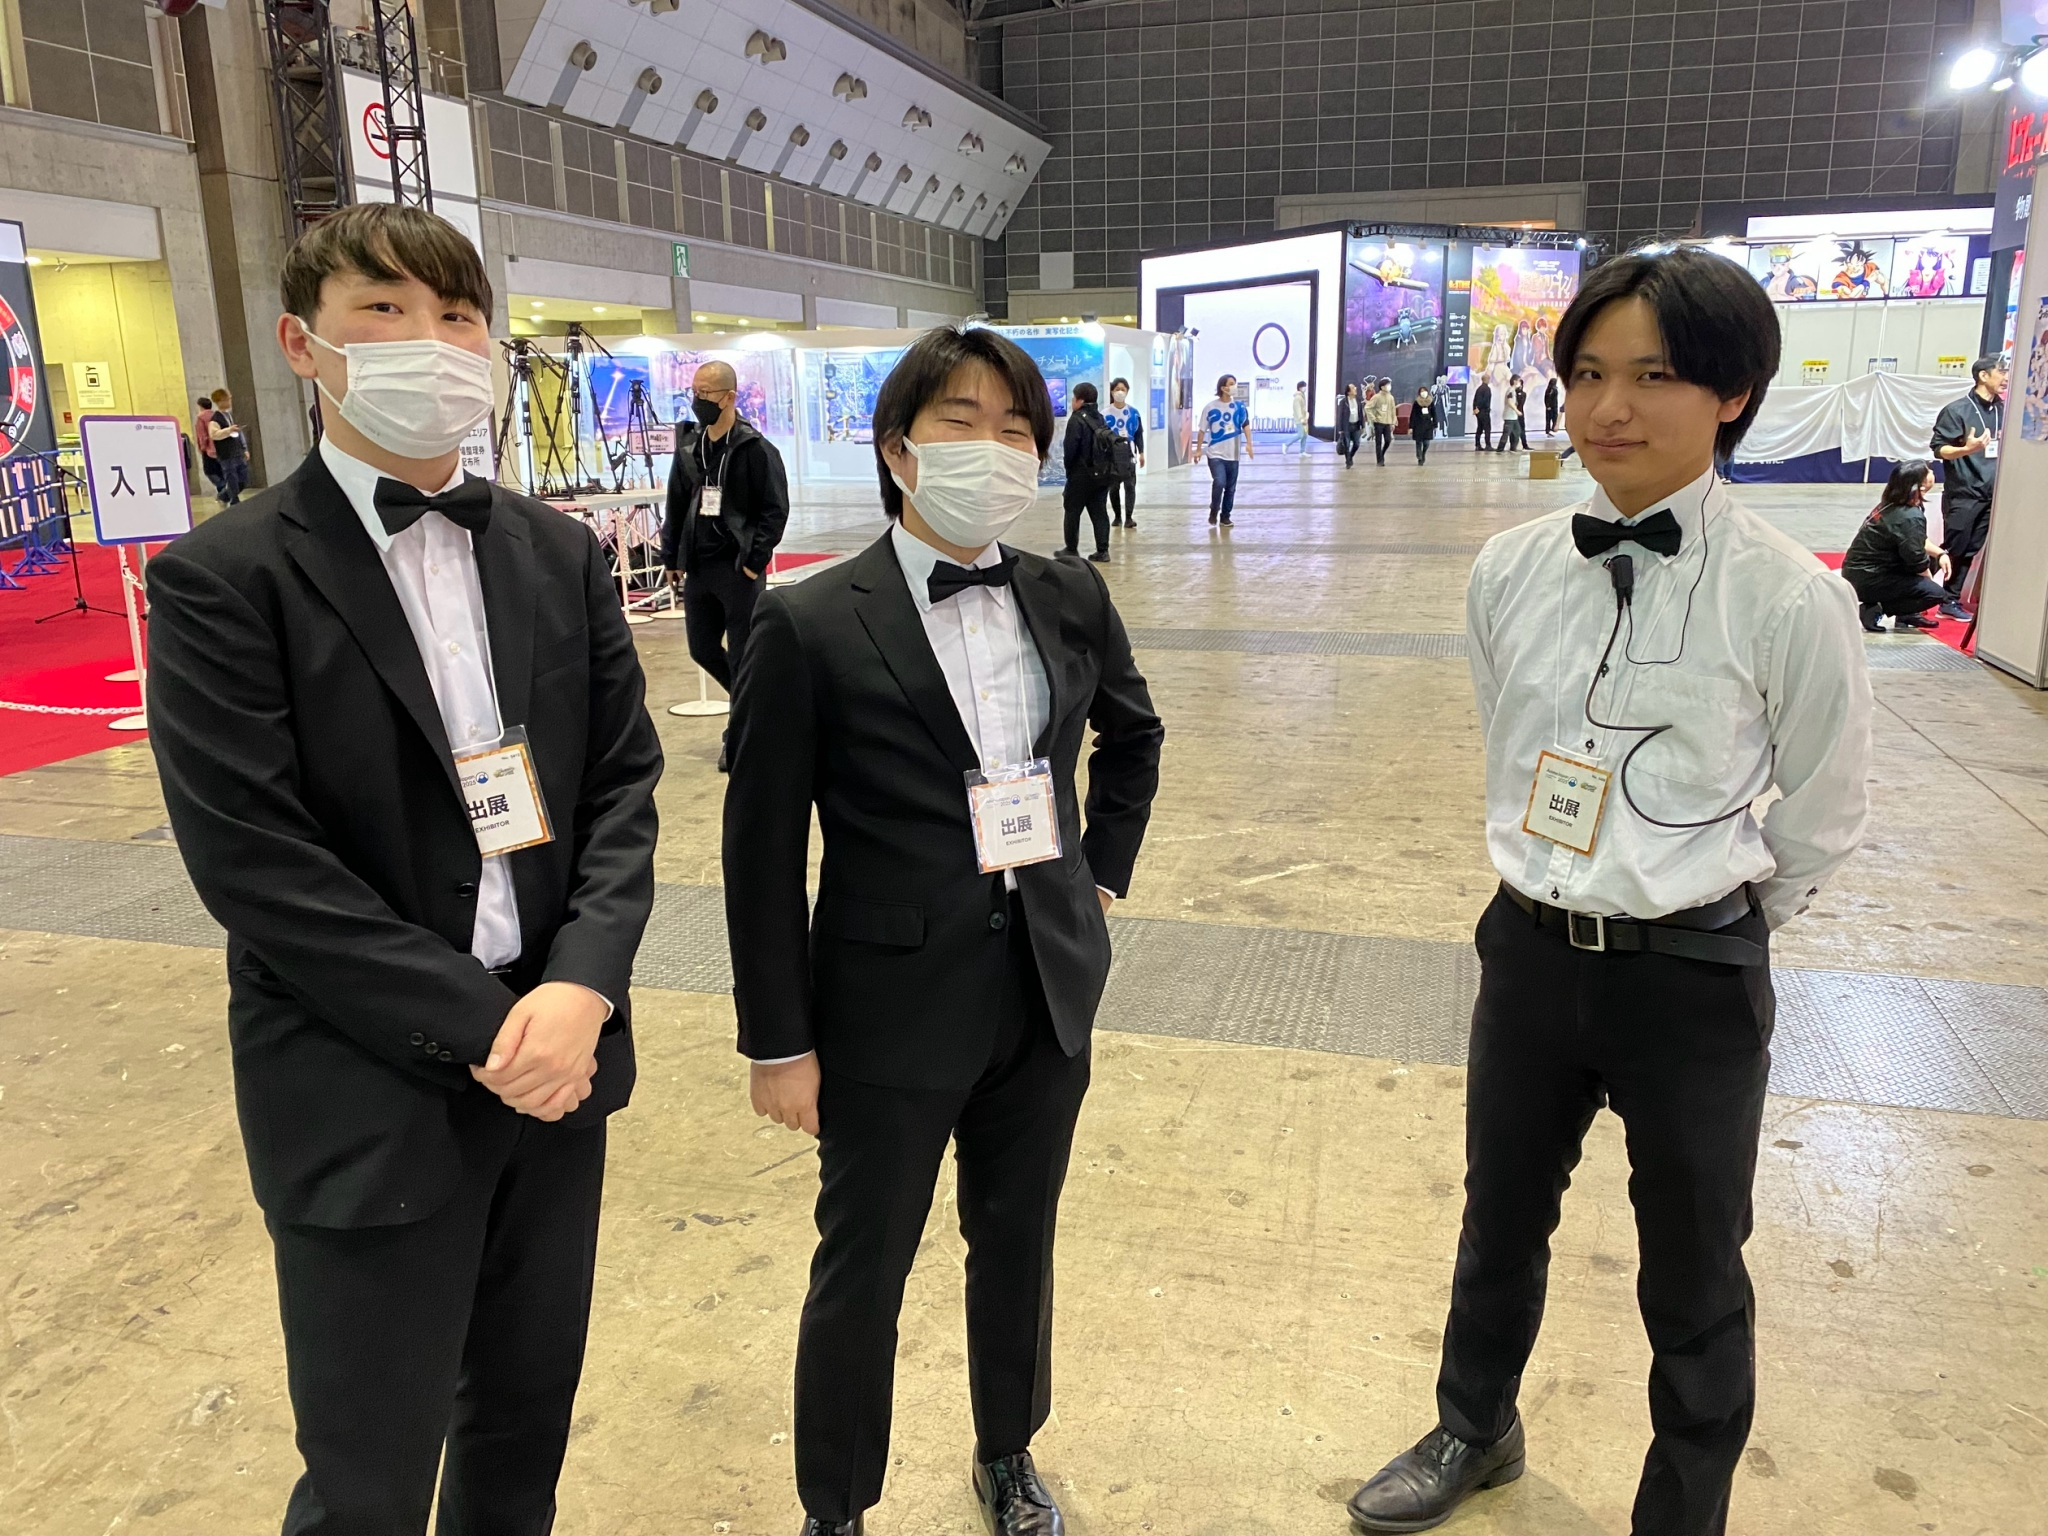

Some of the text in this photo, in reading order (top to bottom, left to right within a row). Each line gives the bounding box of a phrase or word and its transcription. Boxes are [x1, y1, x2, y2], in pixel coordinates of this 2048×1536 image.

[1035, 354, 1082, 366] チメートル
[468, 428, 488, 437] エリア
[110, 466, 170, 498] 入口
[462, 780, 477, 788] 2025
[466, 794, 510, 821] 出展
[1549, 794, 1581, 819] 出展
[474, 820, 510, 834] EXHIBITOR
[1000, 814, 1033, 836] 出展
[1548, 815, 1573, 828] EXHIBITOR
